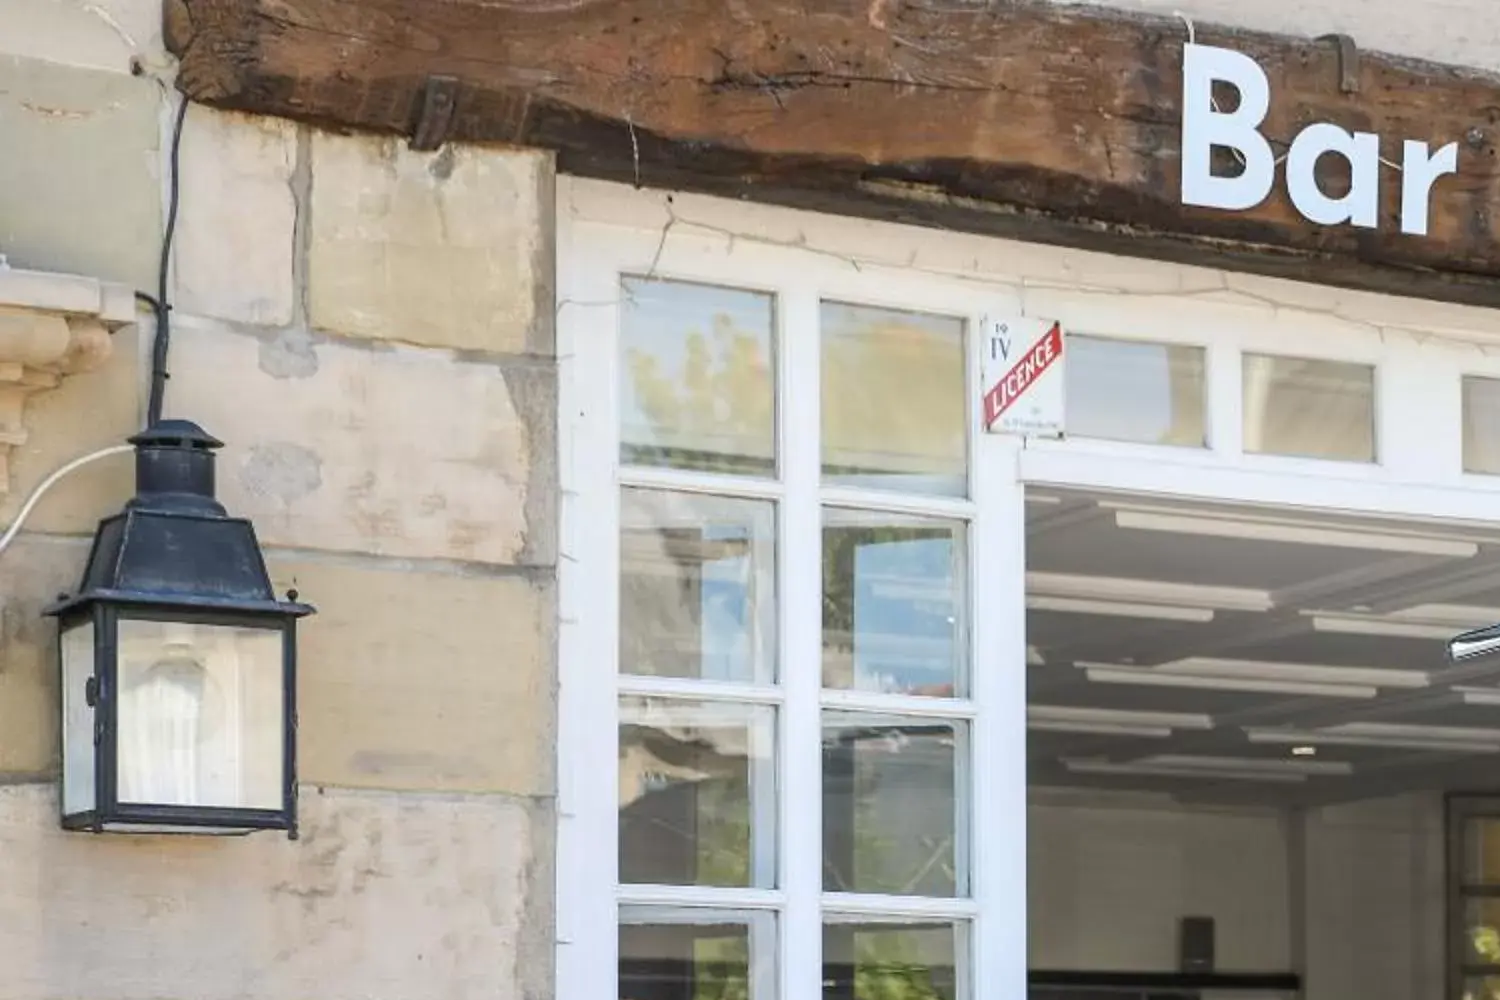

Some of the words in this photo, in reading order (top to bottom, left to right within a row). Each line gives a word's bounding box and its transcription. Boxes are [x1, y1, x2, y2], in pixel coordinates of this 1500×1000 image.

[1181, 43, 1457, 236] Bar
[991, 337, 1011, 361] IV
[992, 334, 1055, 418] LICENCE
